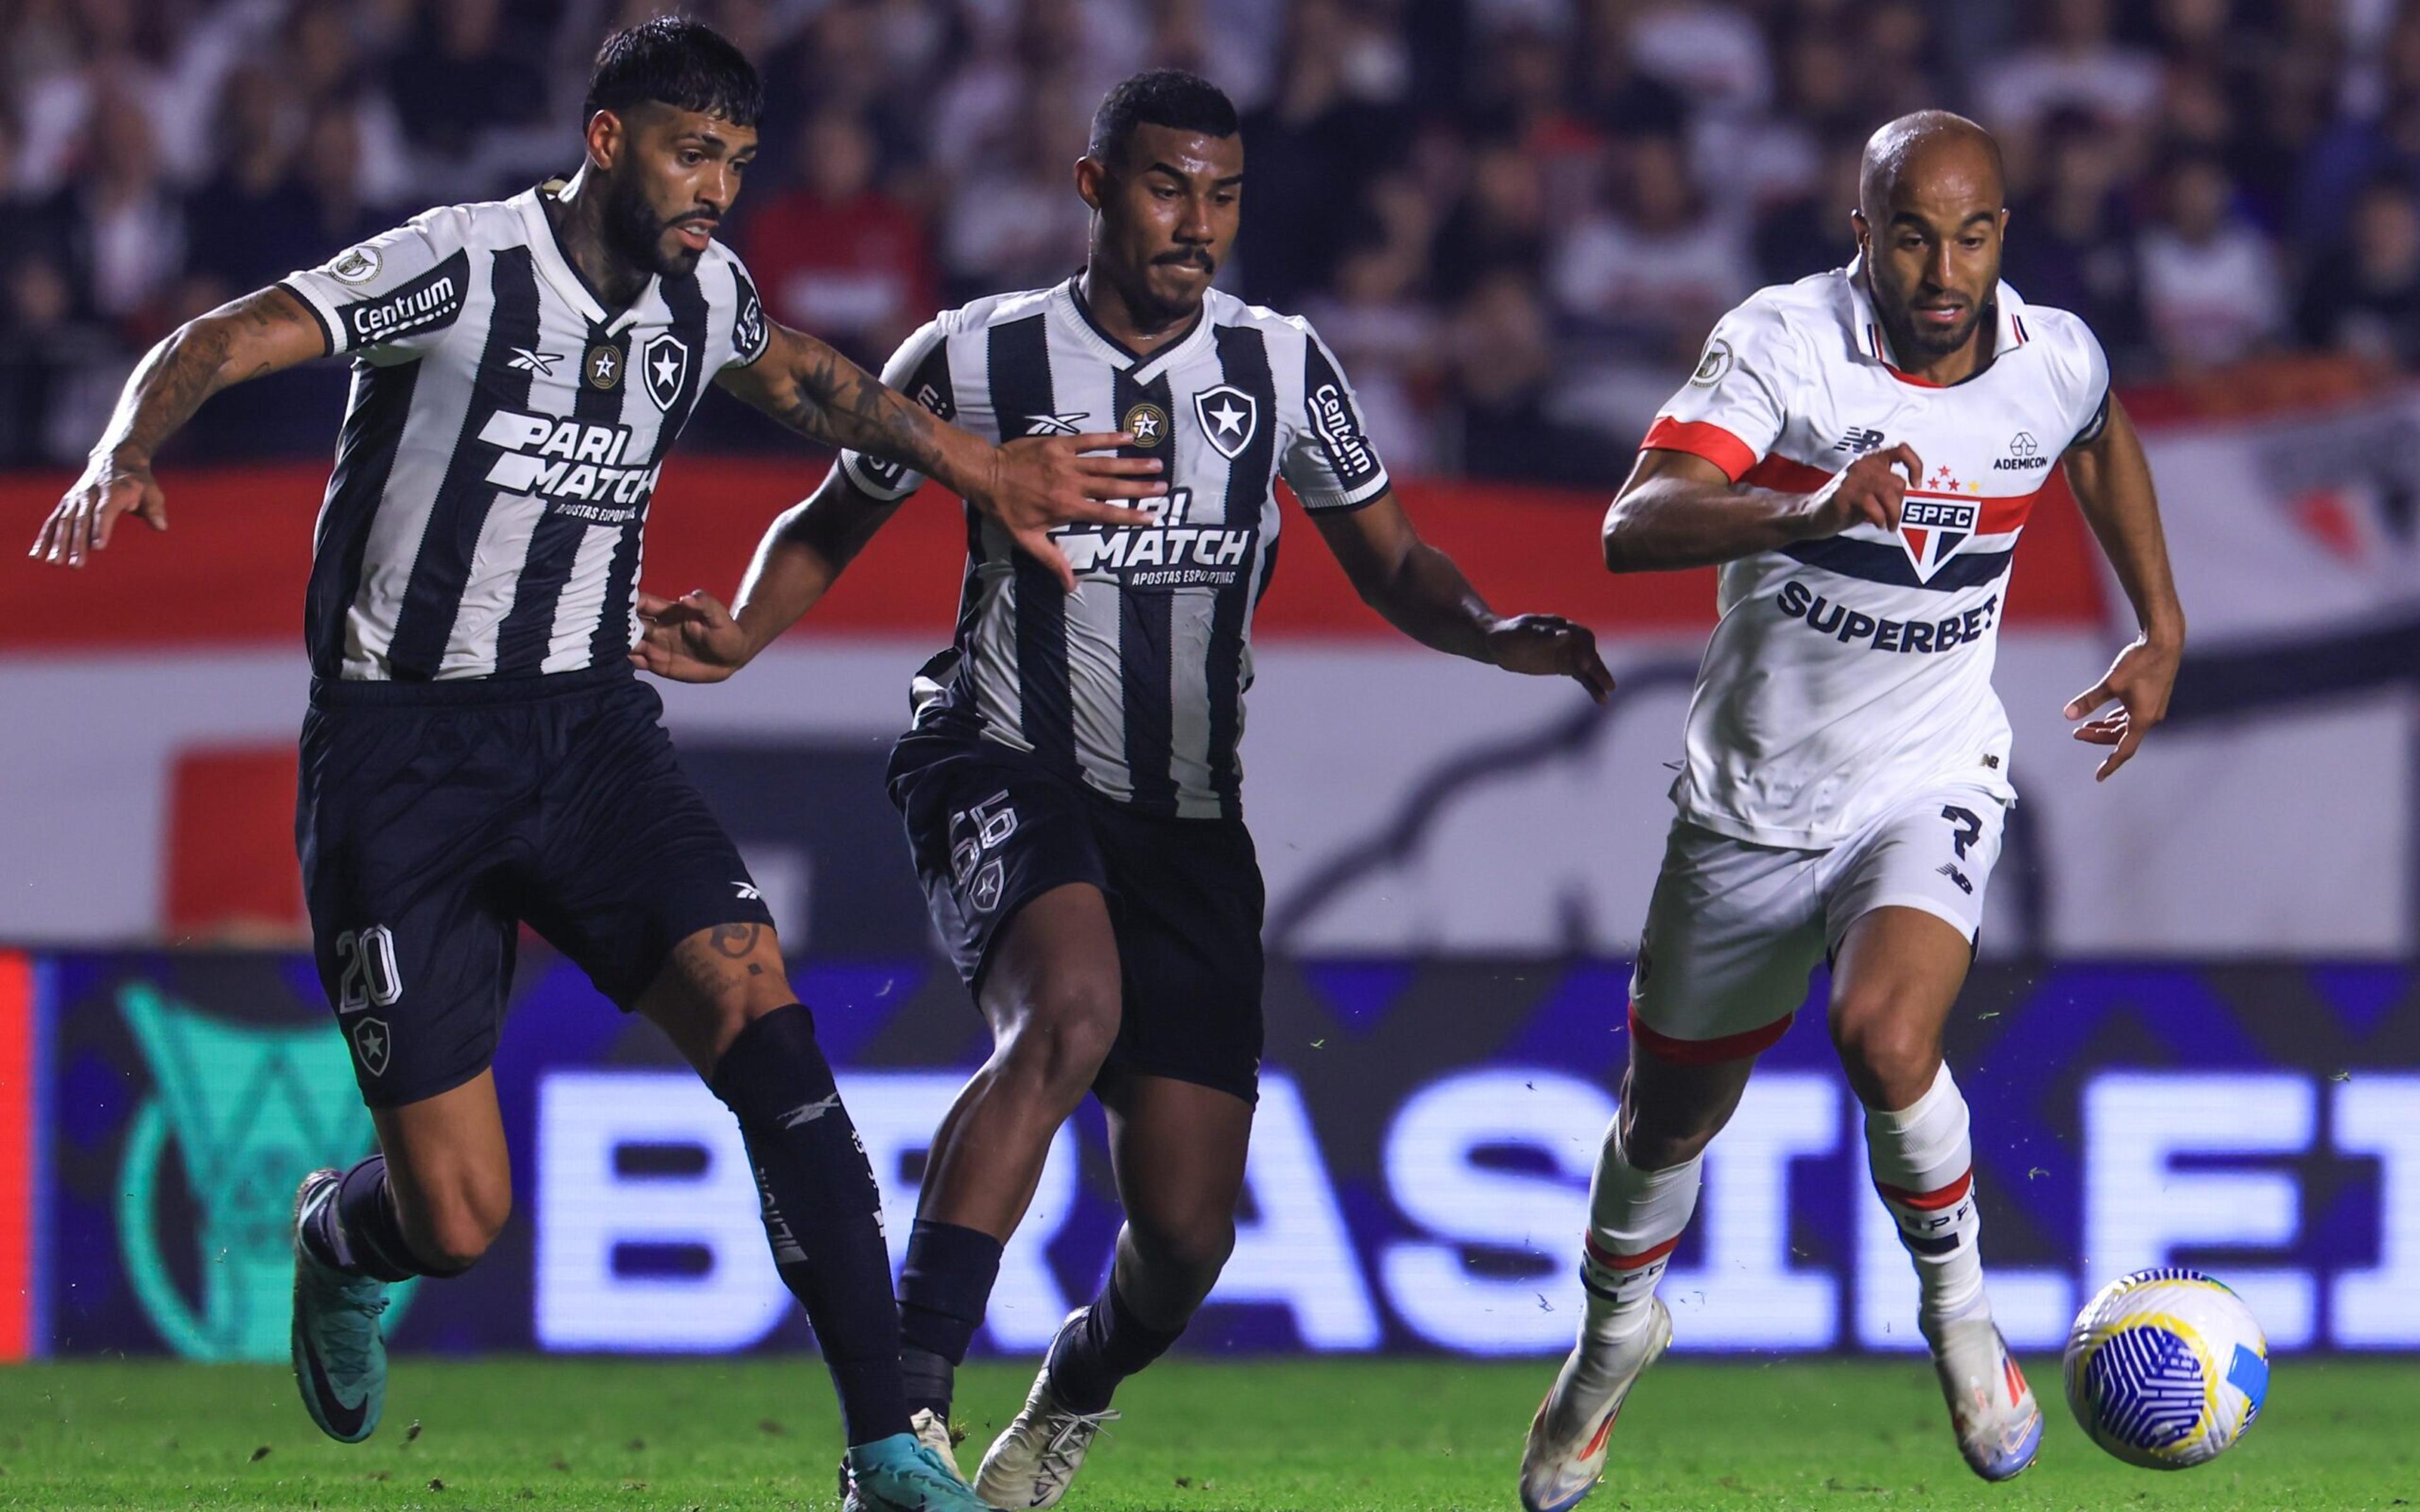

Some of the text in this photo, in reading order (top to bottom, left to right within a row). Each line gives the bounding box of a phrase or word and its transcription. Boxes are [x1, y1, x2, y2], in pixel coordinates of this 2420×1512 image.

[354, 277, 454, 334] Centrum
[477, 410, 628, 466] PARI
[1993, 457, 2048, 470] ADEMICON
[484, 450, 662, 504] MATCH
[1905, 505, 1971, 526] SPFC
[1055, 529, 1250, 569] MATCH
[1132, 570, 1182, 586] APOSTAS
[1777, 580, 1998, 653] SUPERBET
[336, 924, 403, 1014] 20
